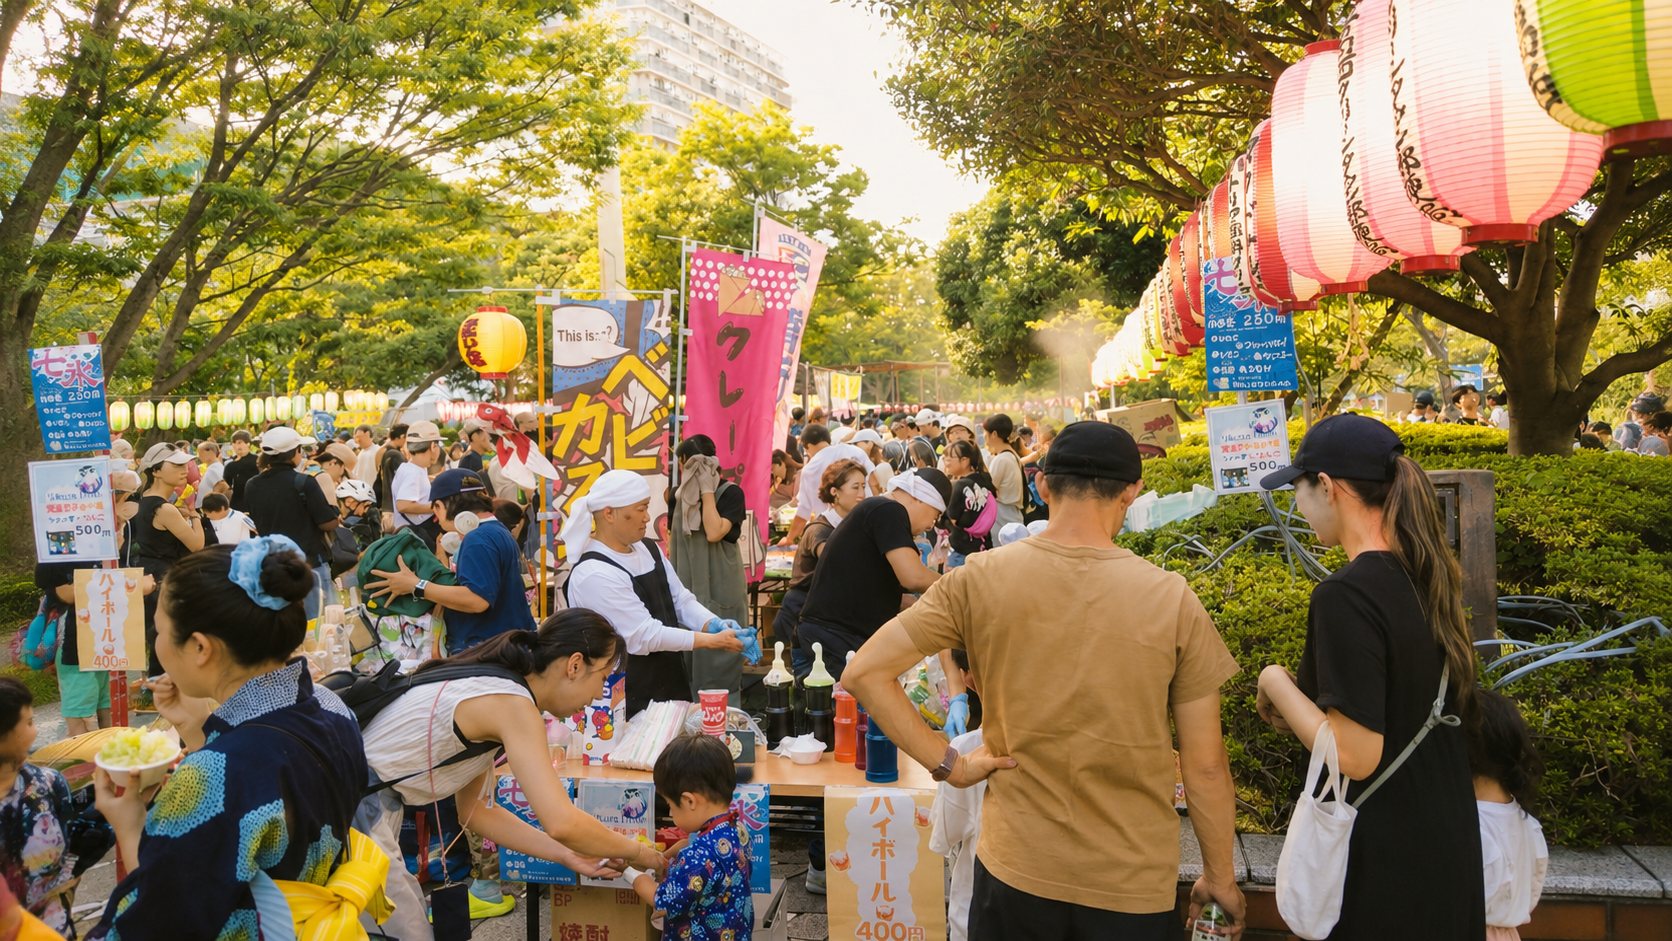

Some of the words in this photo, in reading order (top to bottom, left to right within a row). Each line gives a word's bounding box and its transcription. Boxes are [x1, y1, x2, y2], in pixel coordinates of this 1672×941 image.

[557, 330, 583, 342] This
[869, 796, 896, 902] ハイボール
[856, 921, 924, 941] 400円
